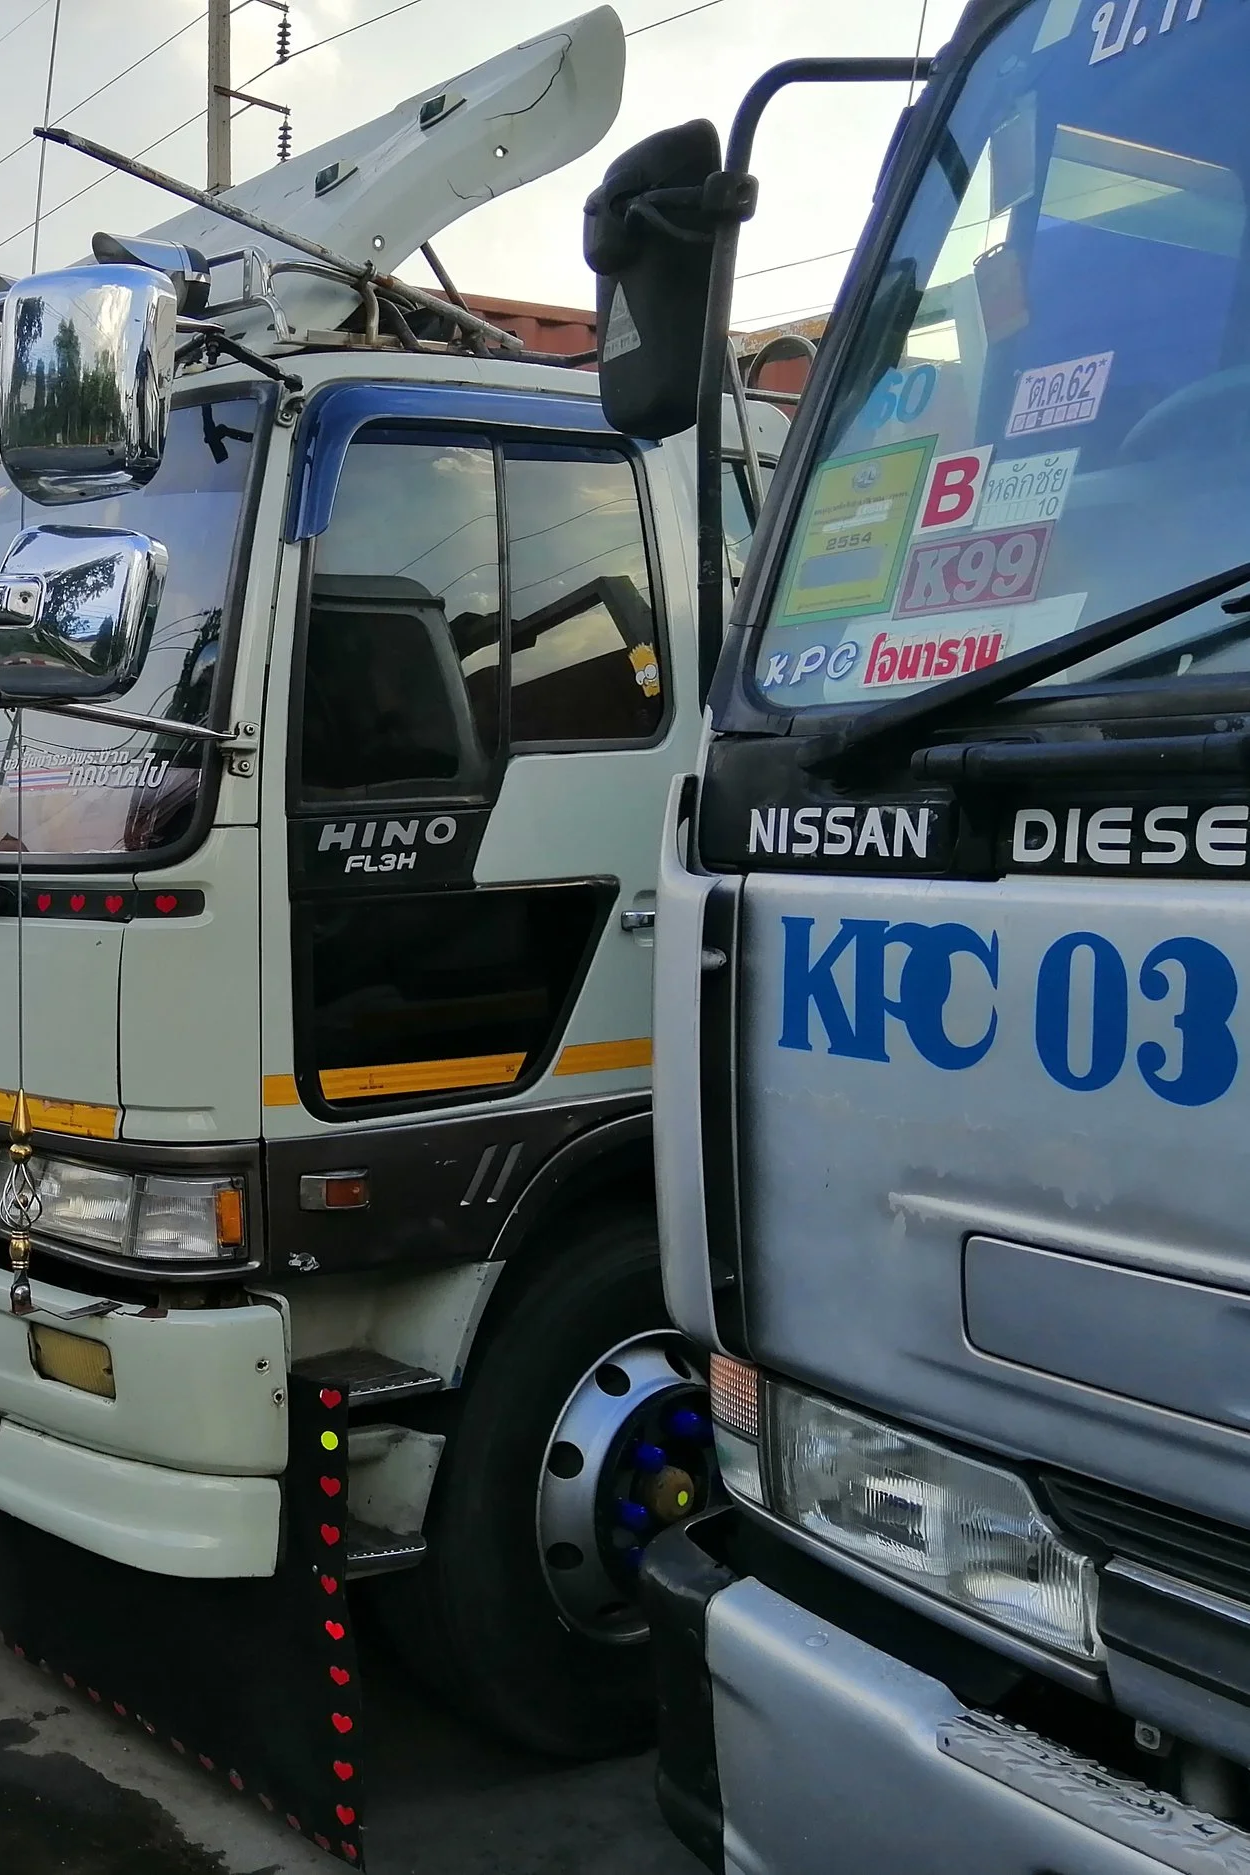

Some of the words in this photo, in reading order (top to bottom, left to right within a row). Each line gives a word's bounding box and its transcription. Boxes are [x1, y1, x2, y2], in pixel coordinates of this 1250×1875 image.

[921, 456, 980, 528] B
[987, 457, 1068, 504] หลักชัย
[1038, 497, 1059, 517] 10
[825, 531, 872, 551] 2554
[905, 533, 1037, 609] K99
[762, 640, 859, 687] KPC
[317, 816, 458, 851] HINO
[749, 807, 930, 858] NISSAN
[1012, 805, 1250, 866] DIESE
[344, 851, 417, 873] FL3H
[778, 914, 999, 1070] KPC
[1035, 931, 1239, 1106] 03
